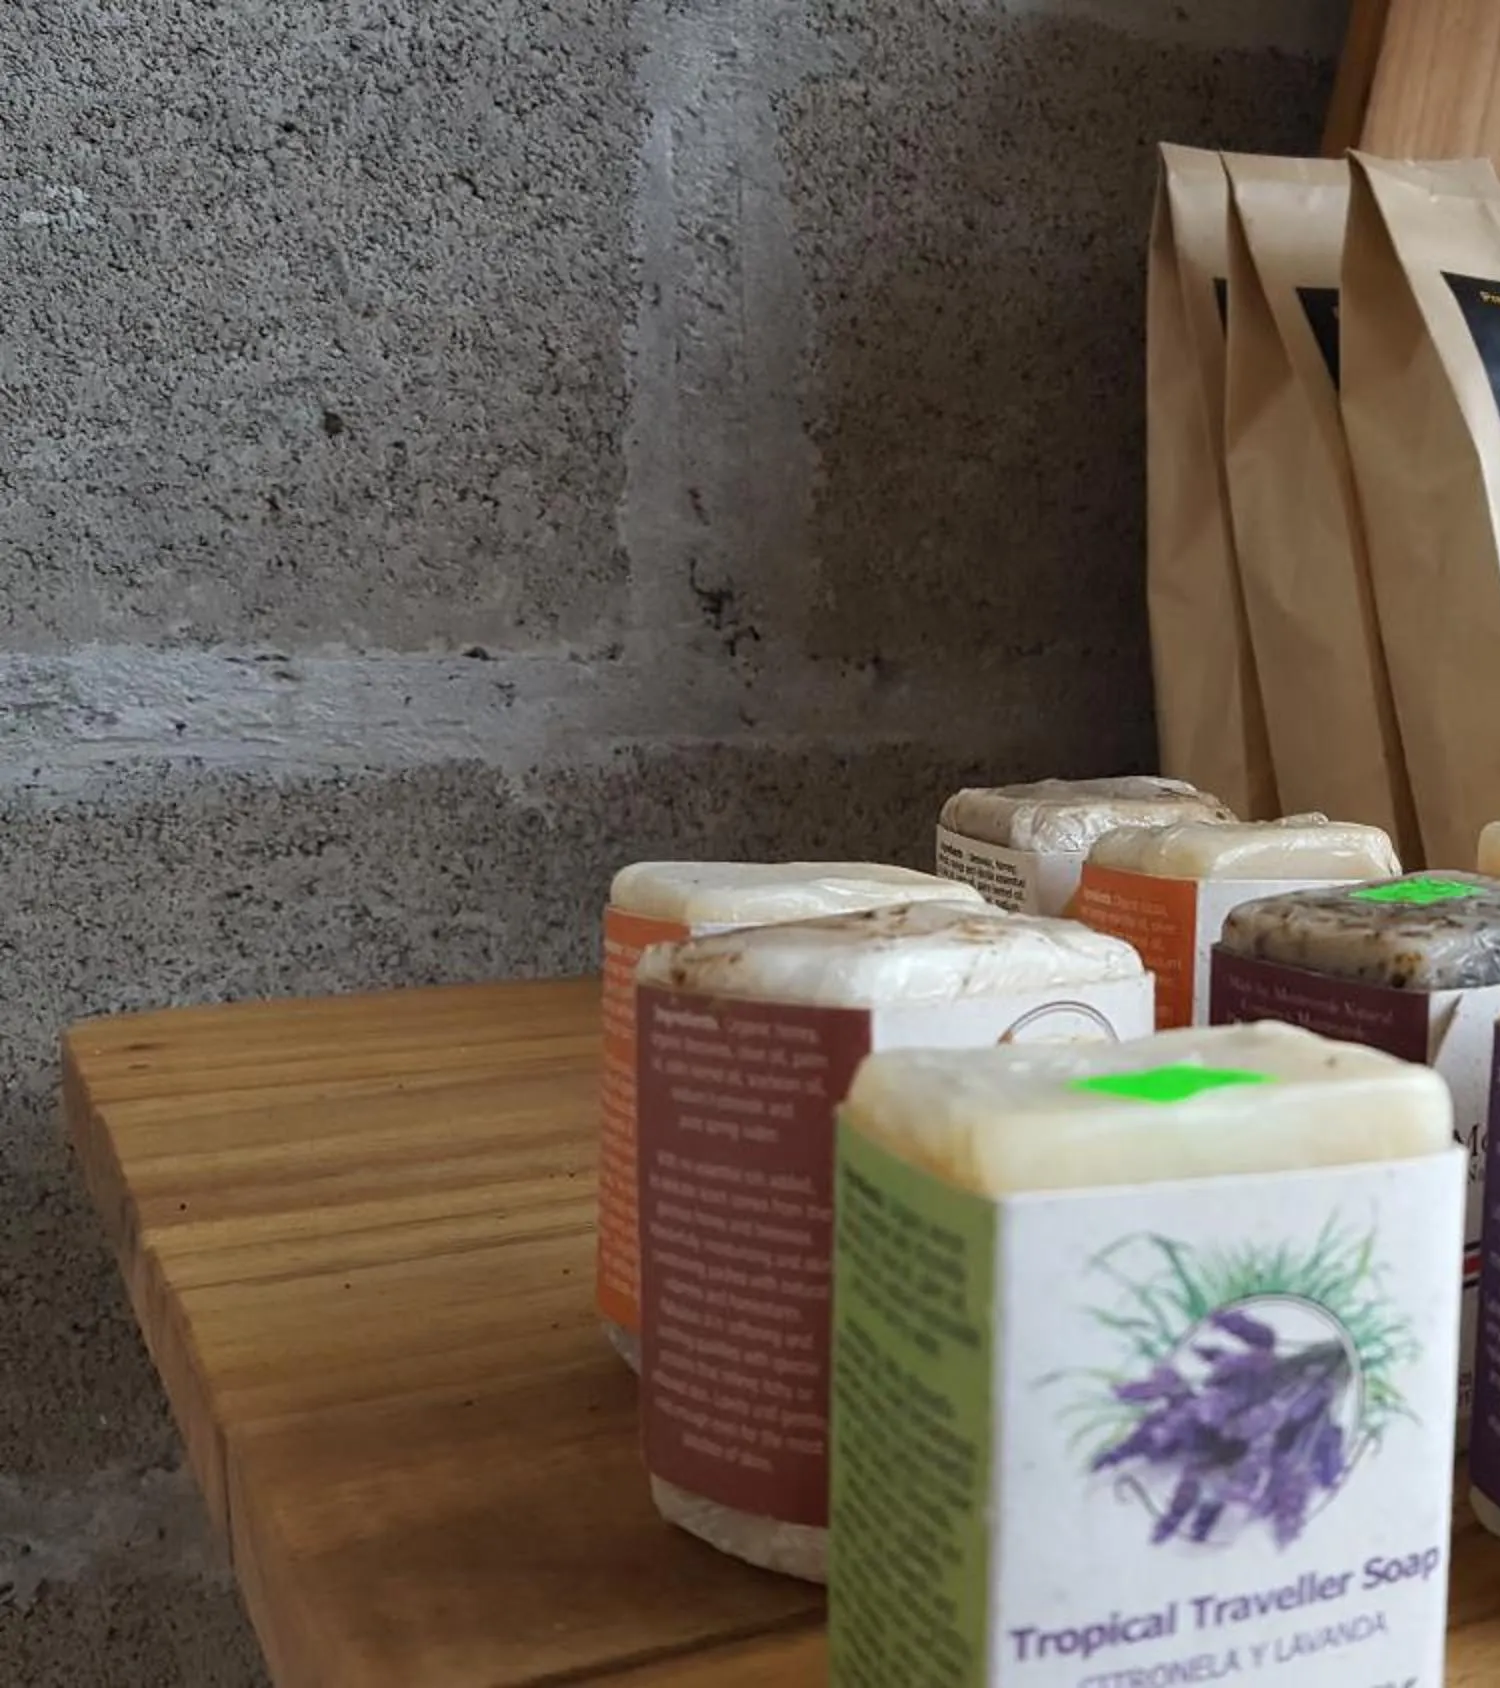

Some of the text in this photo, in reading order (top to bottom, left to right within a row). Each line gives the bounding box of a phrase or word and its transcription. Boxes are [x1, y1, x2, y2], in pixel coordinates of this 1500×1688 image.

[1008, 1546, 1442, 1663] Tropical Traveller Soap
[1247, 1641, 1270, 1668] Y
[1273, 1610, 1391, 1662] LAVANDA
